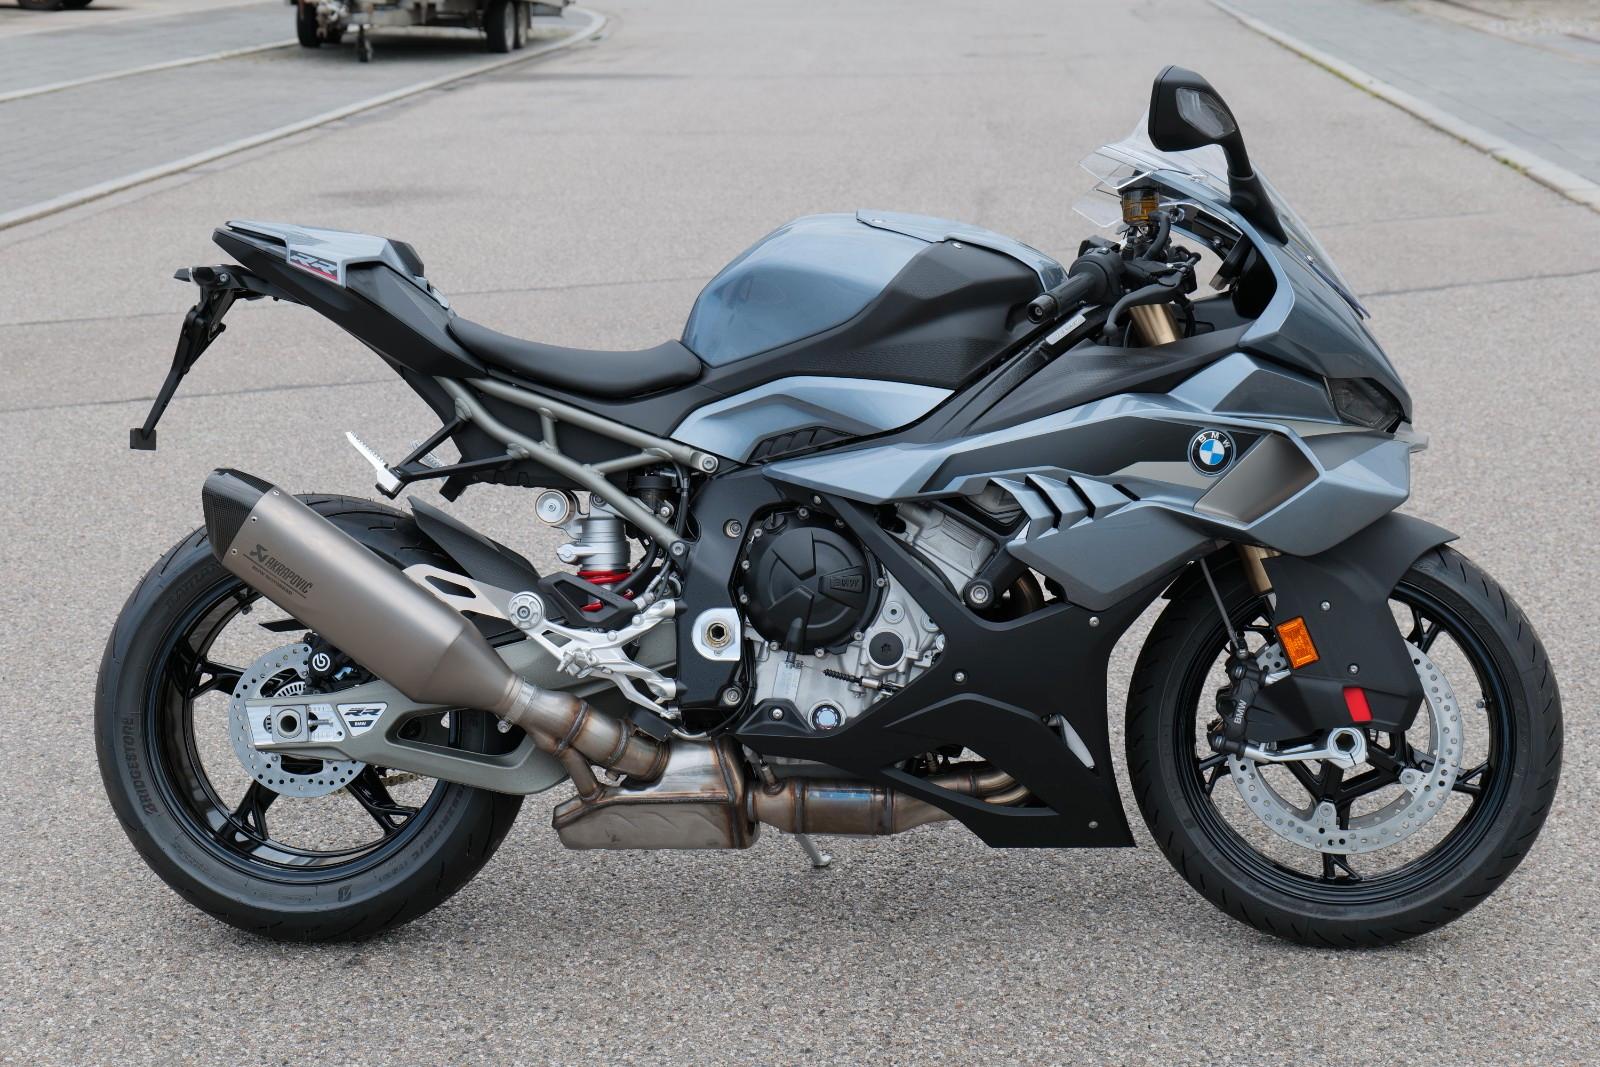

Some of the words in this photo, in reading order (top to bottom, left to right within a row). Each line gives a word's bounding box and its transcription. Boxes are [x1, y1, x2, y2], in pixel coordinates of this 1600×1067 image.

[1198, 431, 1231, 448] BMW
[1234, 699, 1247, 724] BMW
[121, 717, 158, 816] BRIDGESTONE
